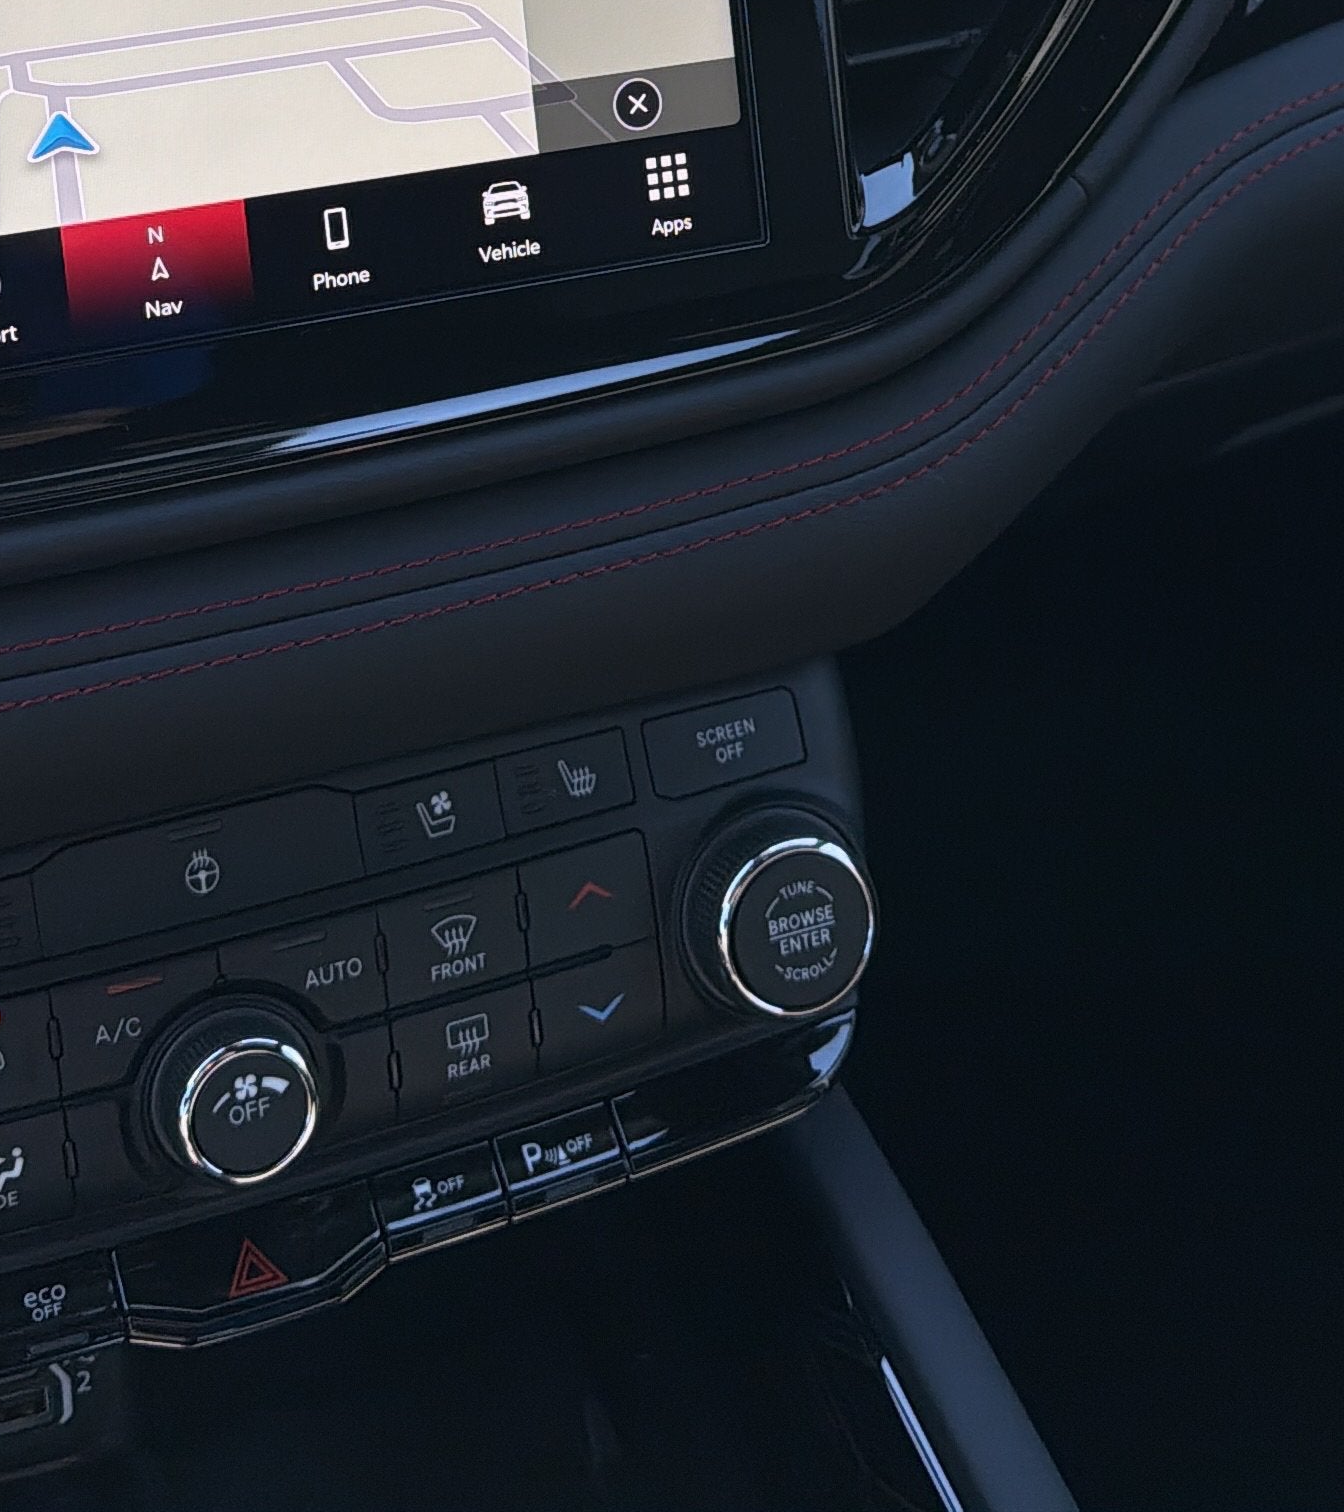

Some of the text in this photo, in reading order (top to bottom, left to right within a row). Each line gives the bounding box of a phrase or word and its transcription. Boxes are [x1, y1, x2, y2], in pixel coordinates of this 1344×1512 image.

[651, 214, 693, 237] Apps
[478, 238, 541, 265] Vehicle
[312, 265, 370, 291] Phone
[145, 297, 183, 320] Nav
[696, 717, 756, 748] SCREEN
[715, 740, 745, 763] OFF
[779, 879, 815, 900] TUNE
[768, 904, 834, 936] BROWSE
[778, 925, 832, 956] ENTER
[304, 956, 364, 989] AUTO
[430, 952, 487, 983] FRONT
[784, 957, 833, 981] SCROLL
[94, 1014, 143, 1046] A/C
[446, 1051, 491, 1080] REAR
[228, 1096, 272, 1125] OFF
[565, 1131, 593, 1157] OFF
[437, 1175, 465, 1196] OFF
[23, 1284, 67, 1309] eco
[31, 1302, 63, 1323] OFF
[75, 1370, 92, 1393] 2
